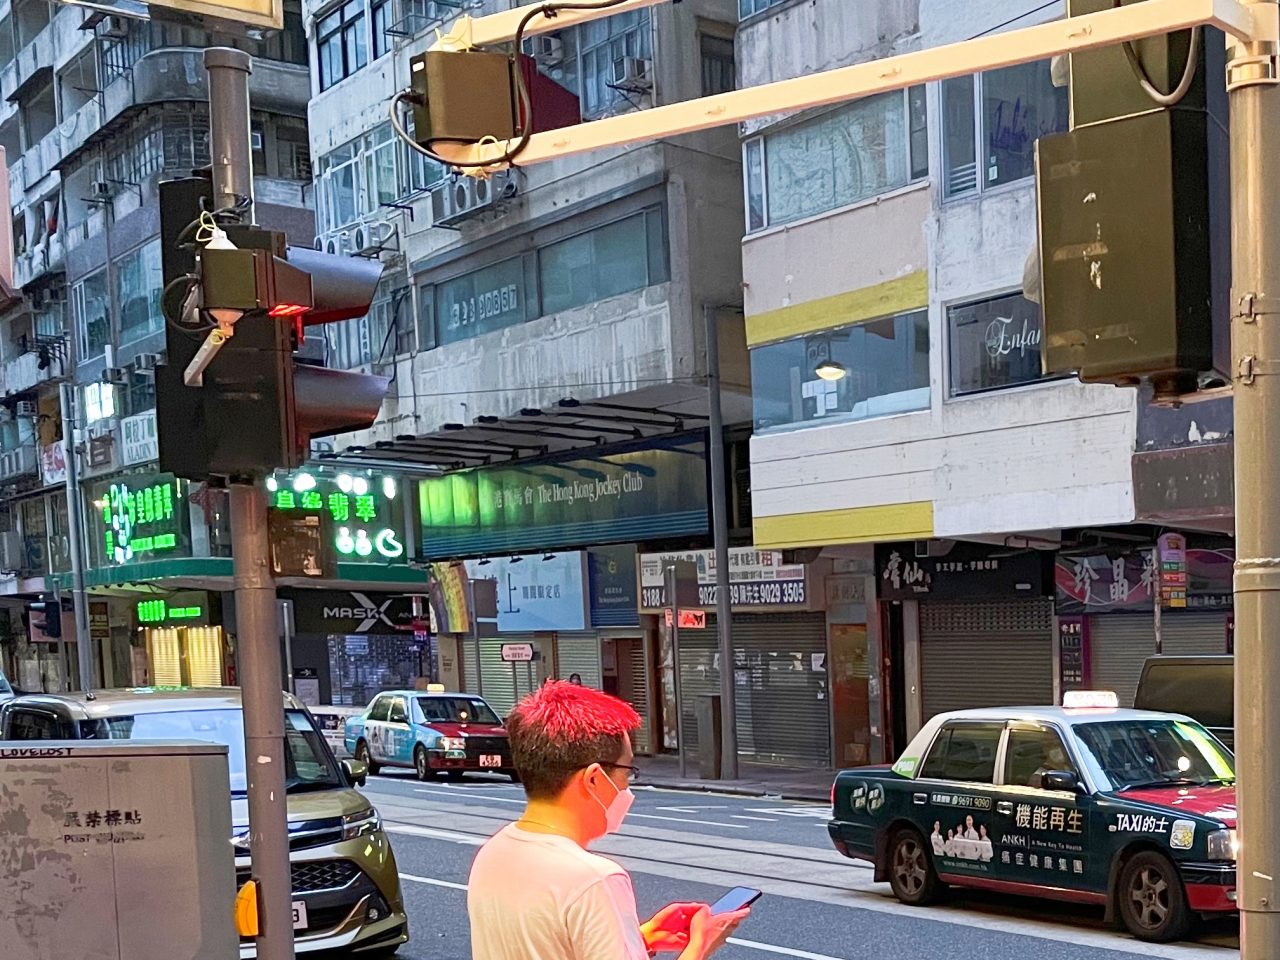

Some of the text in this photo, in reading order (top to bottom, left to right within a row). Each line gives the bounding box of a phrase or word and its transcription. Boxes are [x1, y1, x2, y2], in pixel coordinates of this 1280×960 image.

[538, 484, 551, 504] The
[553, 483, 573, 504] Hong
[574, 480, 594, 502] Kong
[595, 474, 622, 500] Jockey
[623, 471, 643, 492] Club
[760, 583, 781, 603] 9029
[782, 583, 804, 602] 3505
[958, 796, 973, 807] 9691
[1015, 803, 1083, 834] 機能再生
[1002, 834, 1026, 846] ANKH
